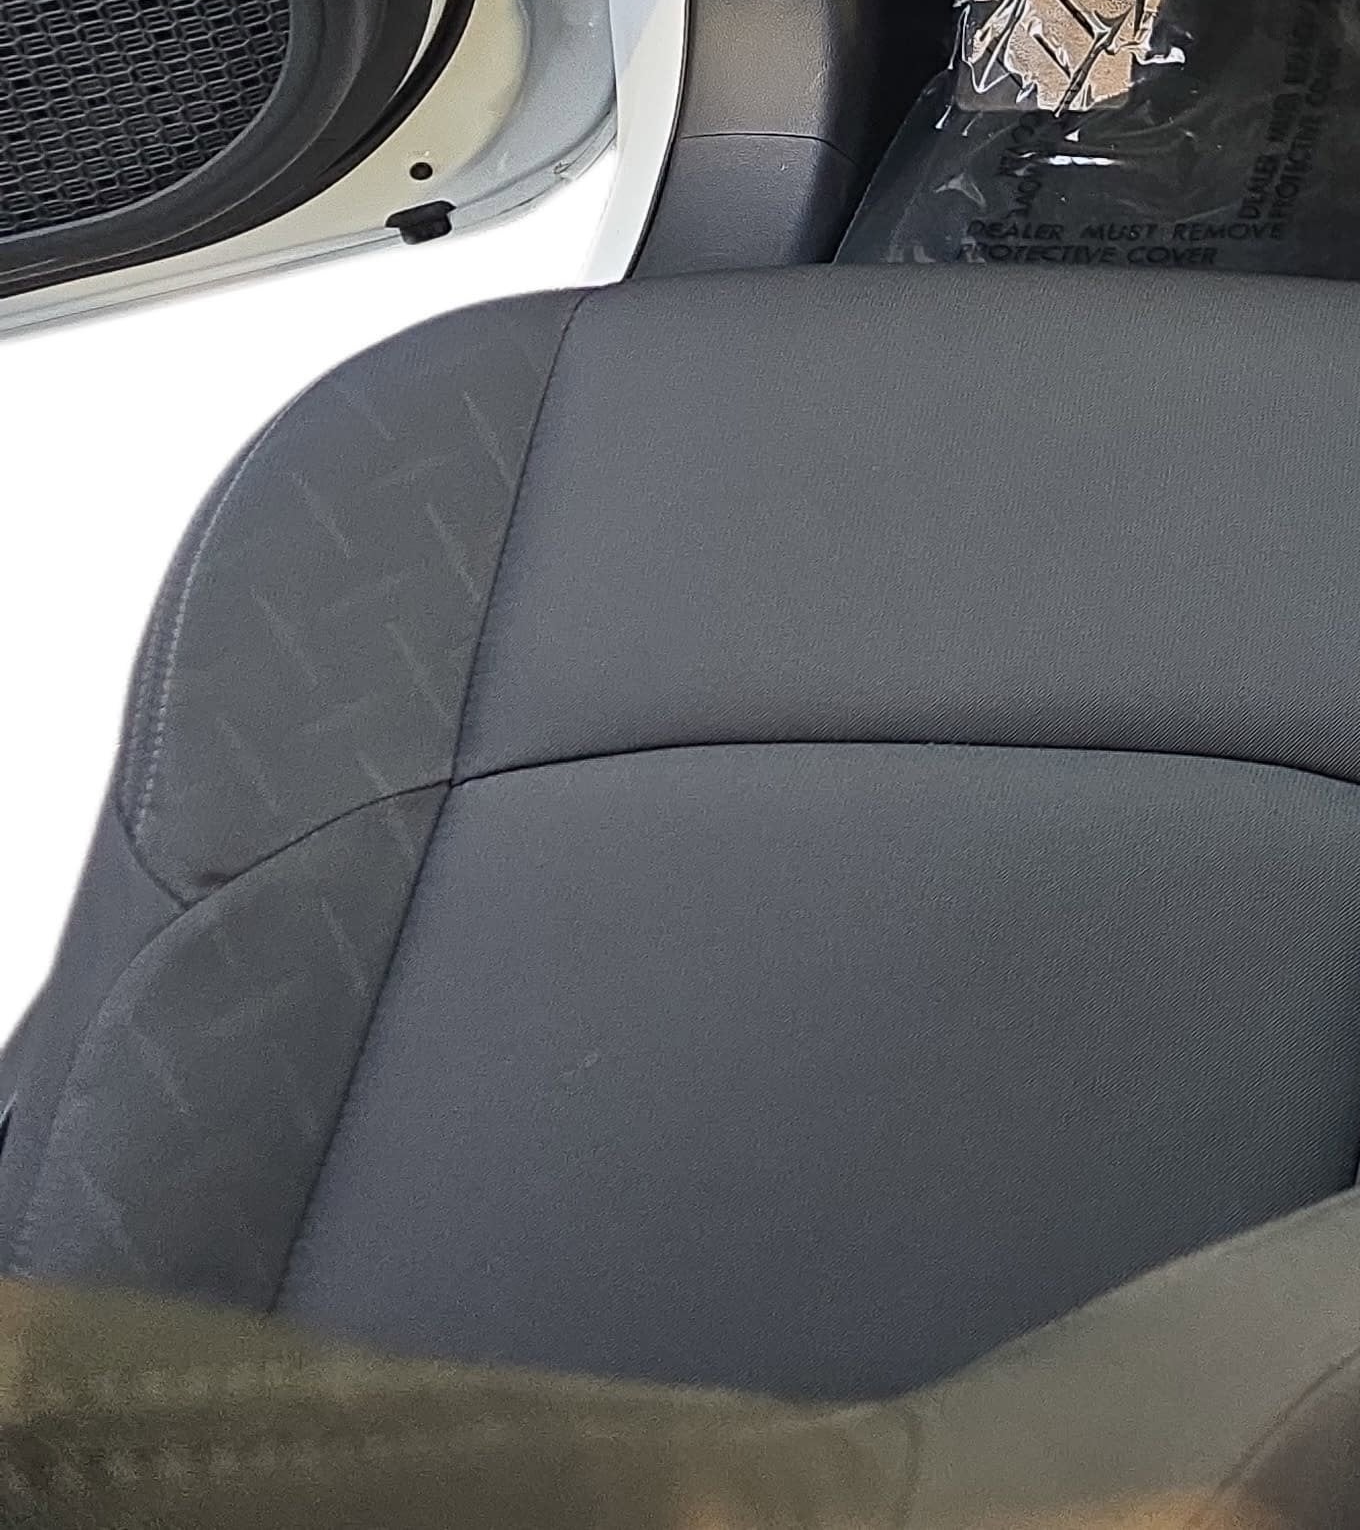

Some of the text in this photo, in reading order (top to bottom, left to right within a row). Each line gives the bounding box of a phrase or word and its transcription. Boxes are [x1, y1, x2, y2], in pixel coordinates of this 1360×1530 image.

[966, 221, 1285, 241] DEALER MUST REMOVE
[1127, 246, 1219, 264] COVER
